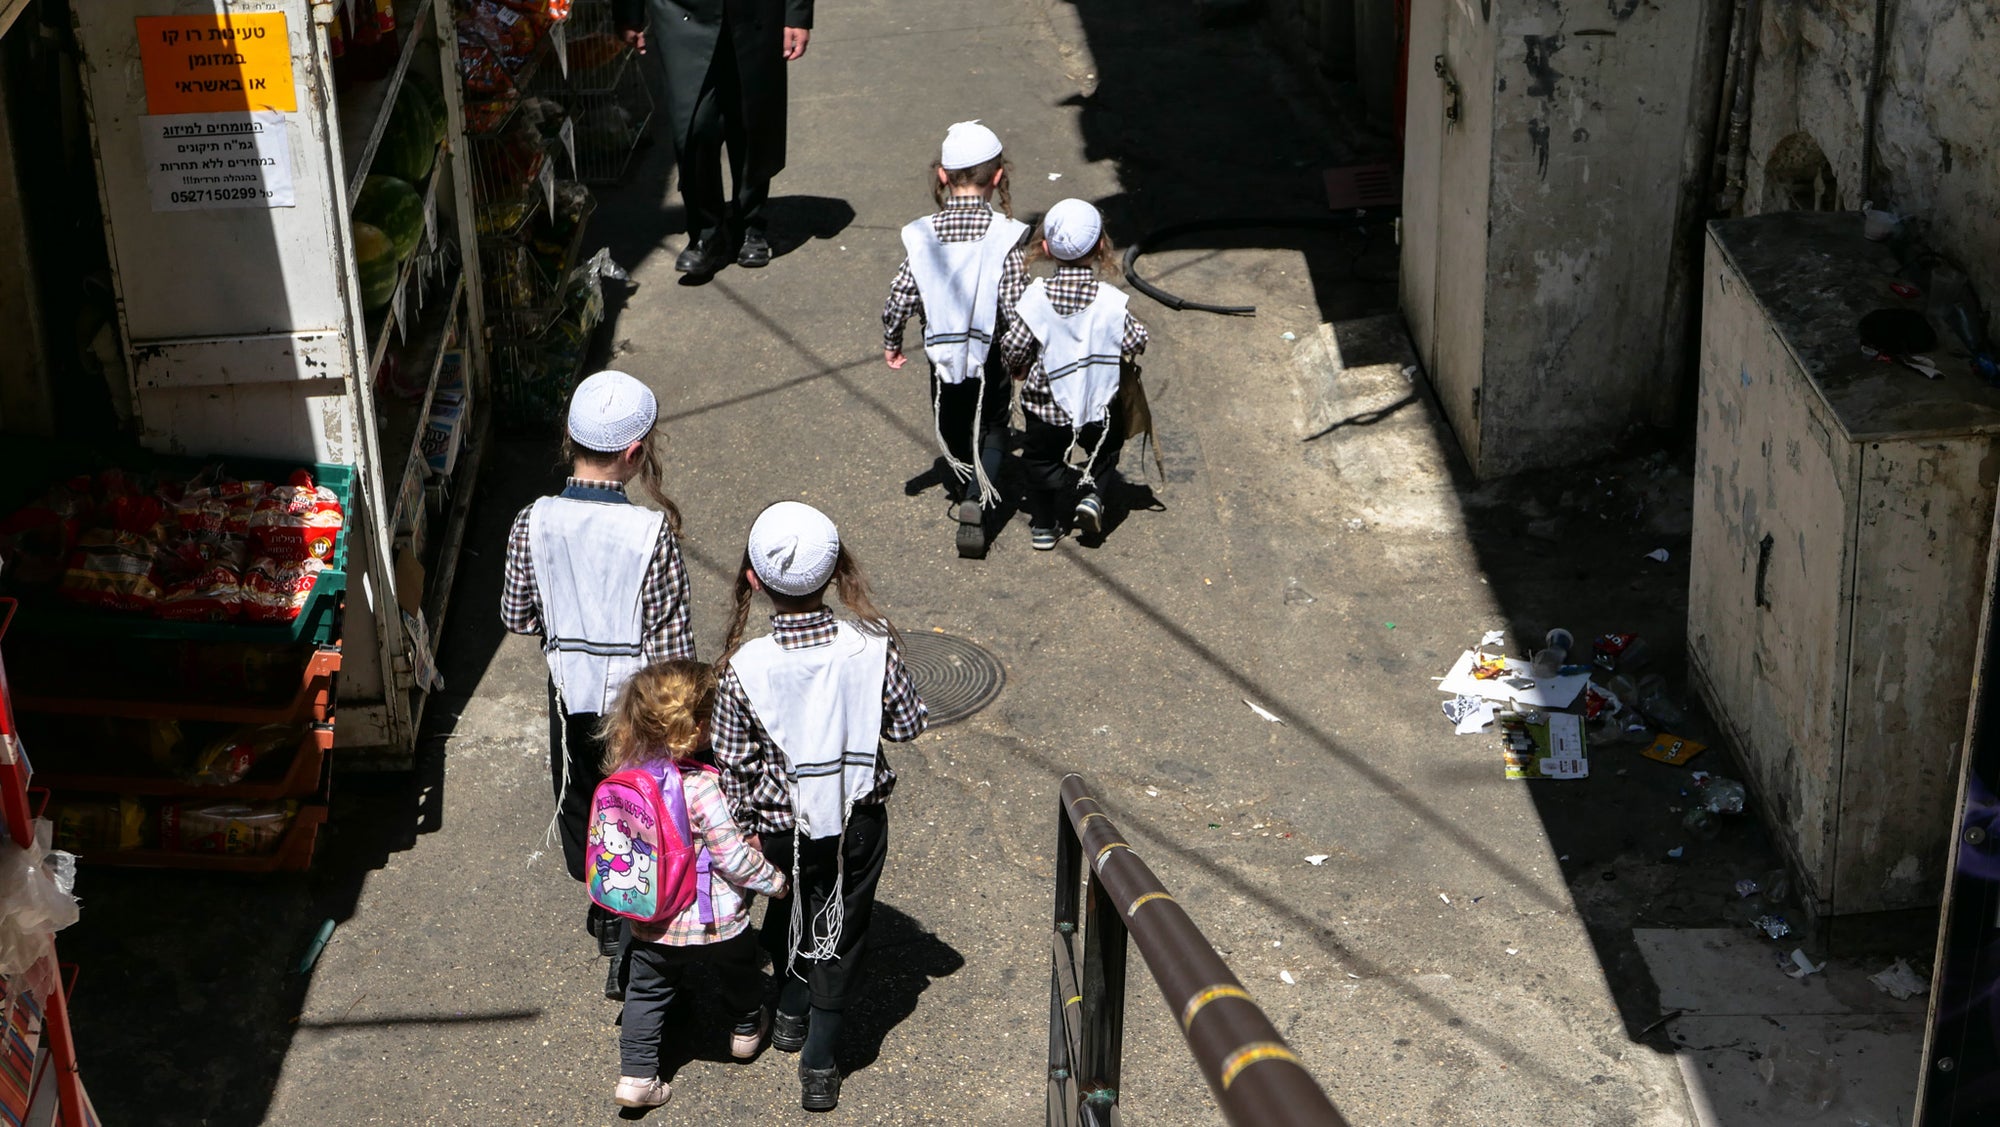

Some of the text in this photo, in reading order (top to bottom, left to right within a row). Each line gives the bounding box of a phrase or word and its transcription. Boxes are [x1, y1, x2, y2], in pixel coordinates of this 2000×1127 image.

[162, 29, 179, 46] קו
[208, 26, 266, 41] טעינות
[188, 53, 247, 70] במזומן
[175, 78, 266, 93] או באשראי
[163, 121, 263, 136] המומחים למיזוג
[177, 139, 254, 154] גמ"ח תיקונים
[160, 157, 276, 172] במחירים ללא תחרות
[223, 174, 257, 183] בהנהלה
[170, 187, 274, 204] טל 0527150299
[596, 796, 655, 830] HELLO KITTY
